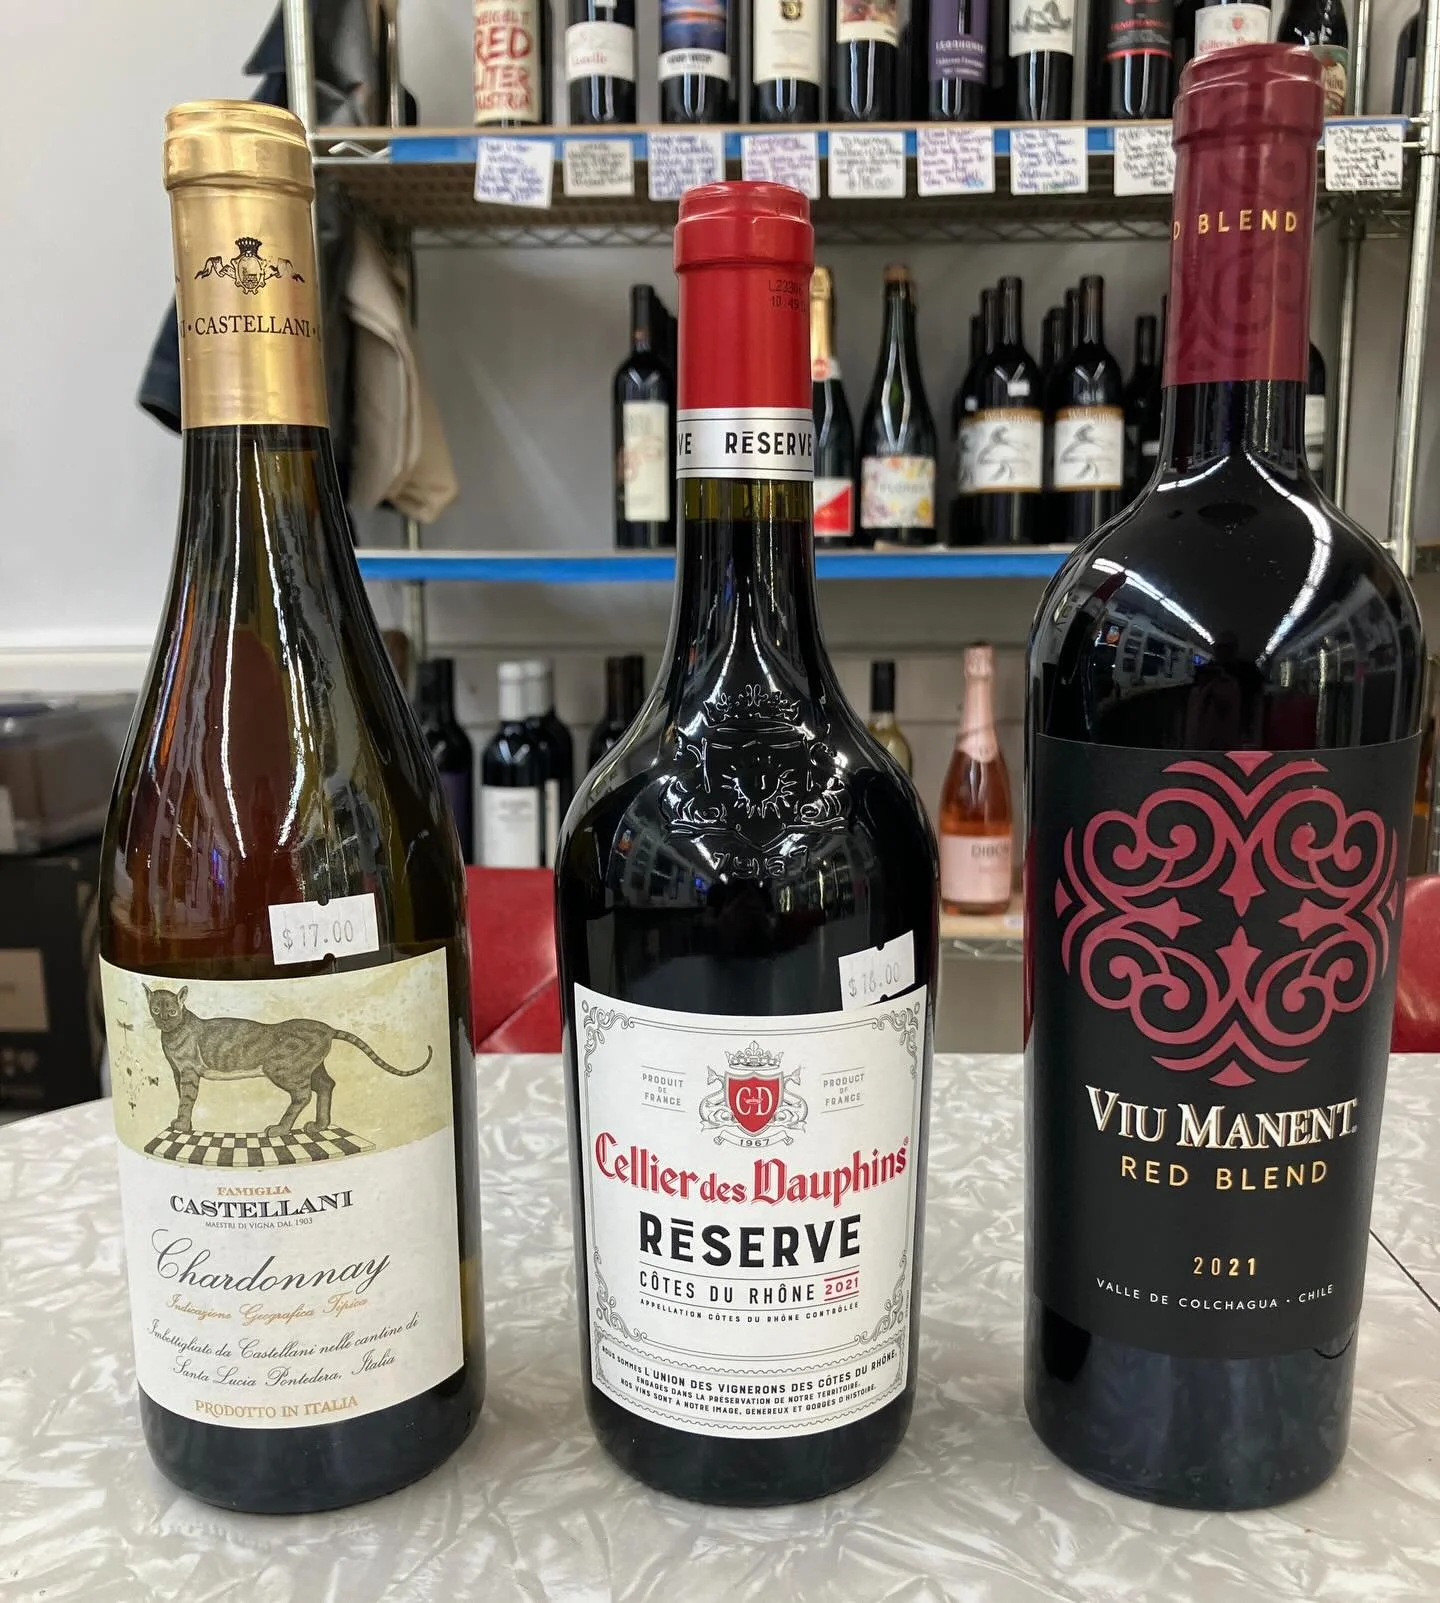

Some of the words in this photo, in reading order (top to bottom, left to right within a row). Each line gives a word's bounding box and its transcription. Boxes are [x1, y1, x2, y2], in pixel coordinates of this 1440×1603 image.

[1198, 209, 1297, 234] BLEND
[194, 315, 311, 338] CASTELLANI
[282, 920, 353, 950] $17.00
[642, 1073, 684, 1088] PRODUIT
[657, 1086, 667, 1094] DE
[823, 1073, 865, 1088] PRODUCT
[645, 1092, 681, 1106] FRANCE
[825, 1092, 861, 1107] FRANCE
[740, 1138, 770, 1147] 1967
[595, 1132, 699, 1198] Cellier
[700, 1172, 748, 1204] des
[1121, 1156, 1189, 1187] RED
[1216, 1160, 1328, 1191] BLEND
[216, 1185, 292, 1196] FAMIGLIA
[170, 1190, 353, 1218] CASTELLANI
[205, 1221, 235, 1229] MAESTRI
[250, 1221, 275, 1229] VIGNA
[277, 1219, 292, 1228] DAL
[295, 1217, 313, 1226] 1903
[151, 1228, 391, 1295] Chardonnay
[1193, 1256, 1256, 1276] 2021
[640, 1267, 695, 1299] CÔTES
[710, 1285, 733, 1303] DU
[750, 1279, 814, 1304] RHÔNE
[825, 1277, 859, 1295] 2021
[1096, 1277, 1140, 1300] VALLE
[1150, 1293, 1168, 1305] DE
[1179, 1298, 1278, 1310] COLCHAGUA
[1298, 1284, 1333, 1303] CHILE
[165, 1293, 232, 1320] Indicazione
[239, 1302, 315, 1326] Geografica
[322, 1291, 368, 1317] Tipica
[640, 1298, 701, 1318] APPELLATION
[708, 1313, 740, 1322] CÔTES
[147, 1318, 212, 1353] Imbottigliato
[215, 1343, 232, 1357] da
[238, 1337, 317, 1359] Castellani
[319, 1331, 355, 1354] nelle
[354, 1326, 402, 1347] cantine
[405, 1311, 421, 1330] di
[173, 1355, 210, 1382] Santa
[213, 1365, 257, 1387] Lucia
[351, 1348, 396, 1375] Italia
[617, 1355, 642, 1374] SOMMES
[690, 1379, 712, 1392] DES
[718, 1383, 786, 1395] VIGNERONS
[791, 1381, 813, 1392] DES
[818, 1372, 851, 1388] CÔTES
[855, 1365, 868, 1377] DU
[195, 1400, 276, 1418] PRODOTTO
[282, 1405, 298, 1417] IN
[304, 1395, 358, 1416] ITALIA
[620, 1378, 633, 1389] NOS
[635, 1385, 651, 1397] VINS
[653, 1393, 673, 1404] SONT
[684, 1401, 709, 1412] NOTRE
[792, 1405, 802, 1413] ET
[671, 1388, 692, 1399] DANS
[696, 1393, 705, 1401] LA
[788, 1393, 814, 1403] NOTRE
